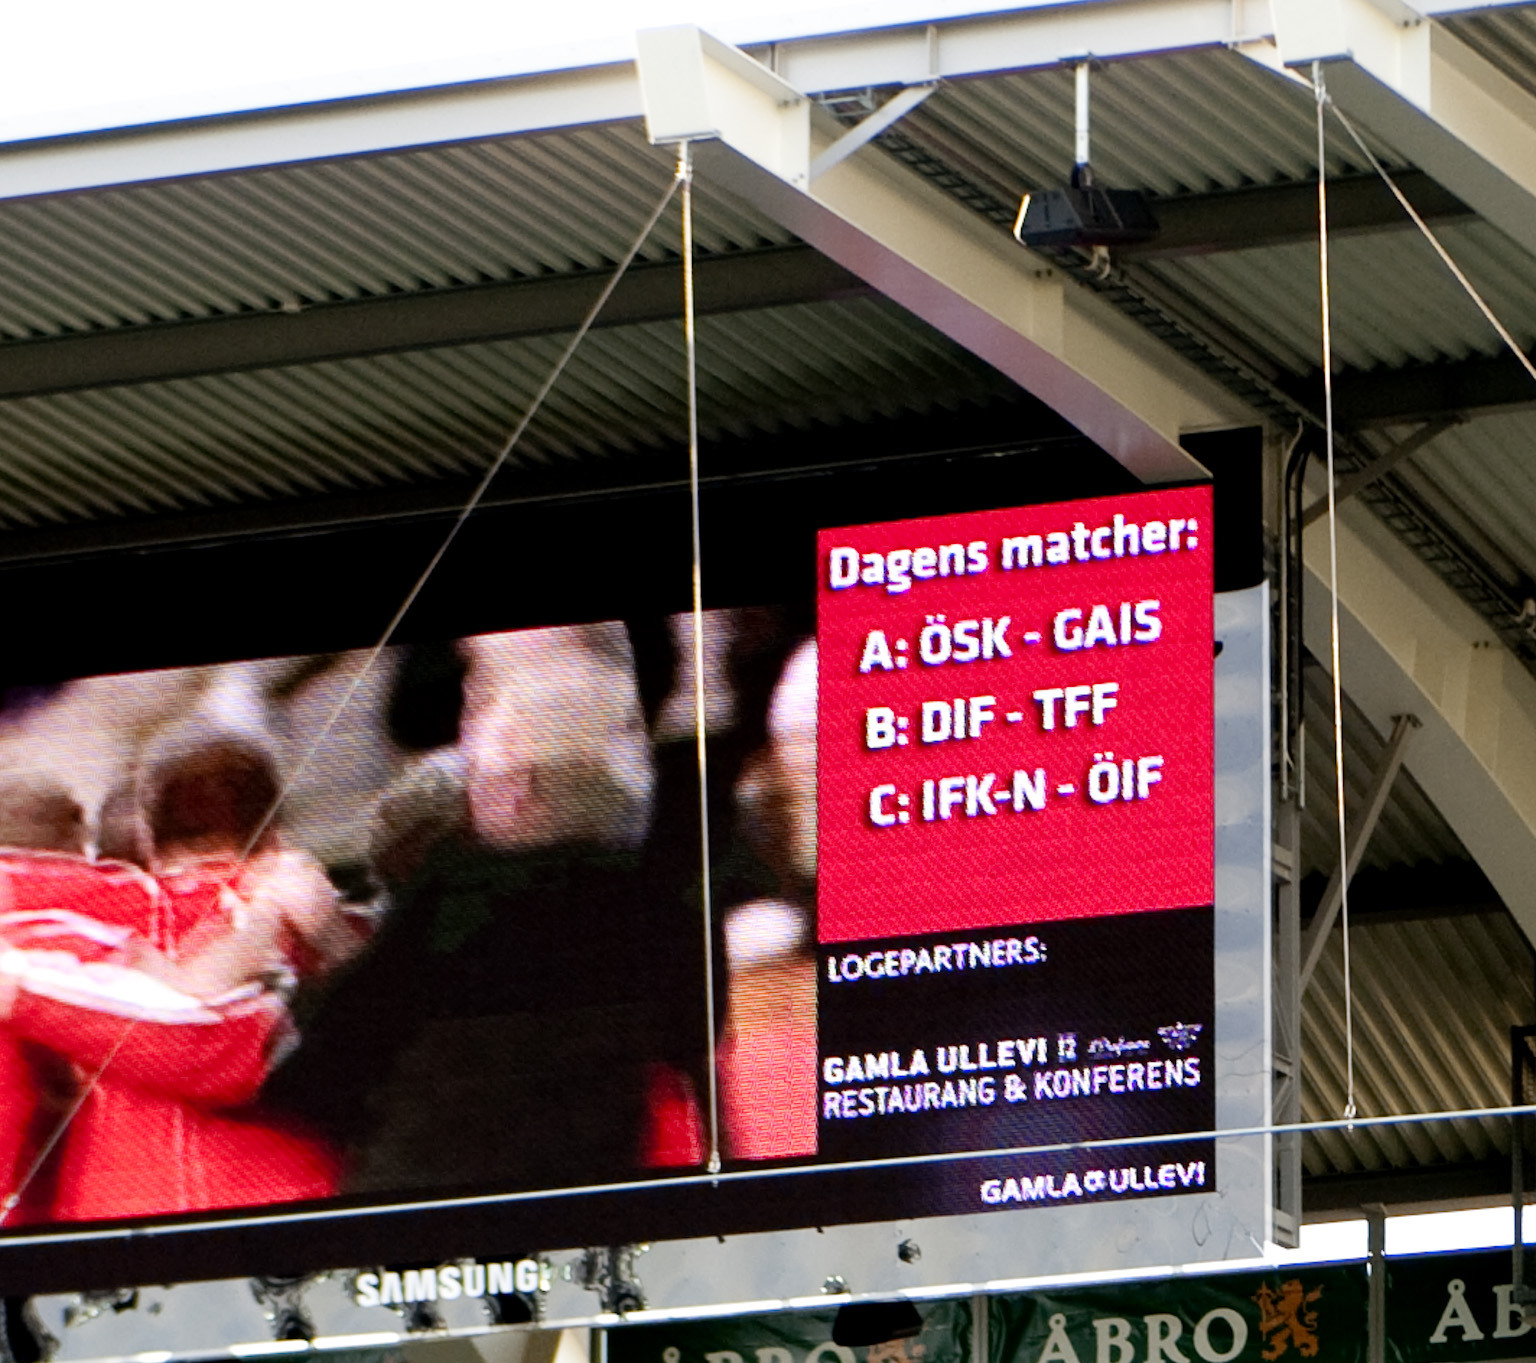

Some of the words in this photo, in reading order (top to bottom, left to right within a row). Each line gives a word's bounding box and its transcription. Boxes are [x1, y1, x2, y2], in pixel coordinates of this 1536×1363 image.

[828, 535, 989, 594] Dagens
[1001, 513, 1200, 572] matcher:
[859, 630, 909, 674] A:
[918, 612, 1014, 665] ÖSK
[1053, 598, 1163, 651] GAIS
[866, 705, 911, 751] B:
[921, 694, 997, 744] DIF
[1033, 682, 1120, 732] TFF
[868, 782, 911, 828] C:
[922, 766, 1048, 823] IFK-N
[1087, 753, 1165, 806] ÖIF
[827, 937, 1048, 984] LOGEPARTNERS:
[822, 1050, 930, 1086] GAMLA
[935, 1037, 1049, 1076] ULLEVI
[822, 1075, 996, 1120] RESTAURANG
[1004, 1073, 1026, 1104] &
[1034, 1056, 1202, 1101] KONFERENS
[979, 1173, 1082, 1205] GAMLA
[1107, 1161, 1206, 1193] ULLEVI
[355, 1257, 540, 1308] SAMSUNG
